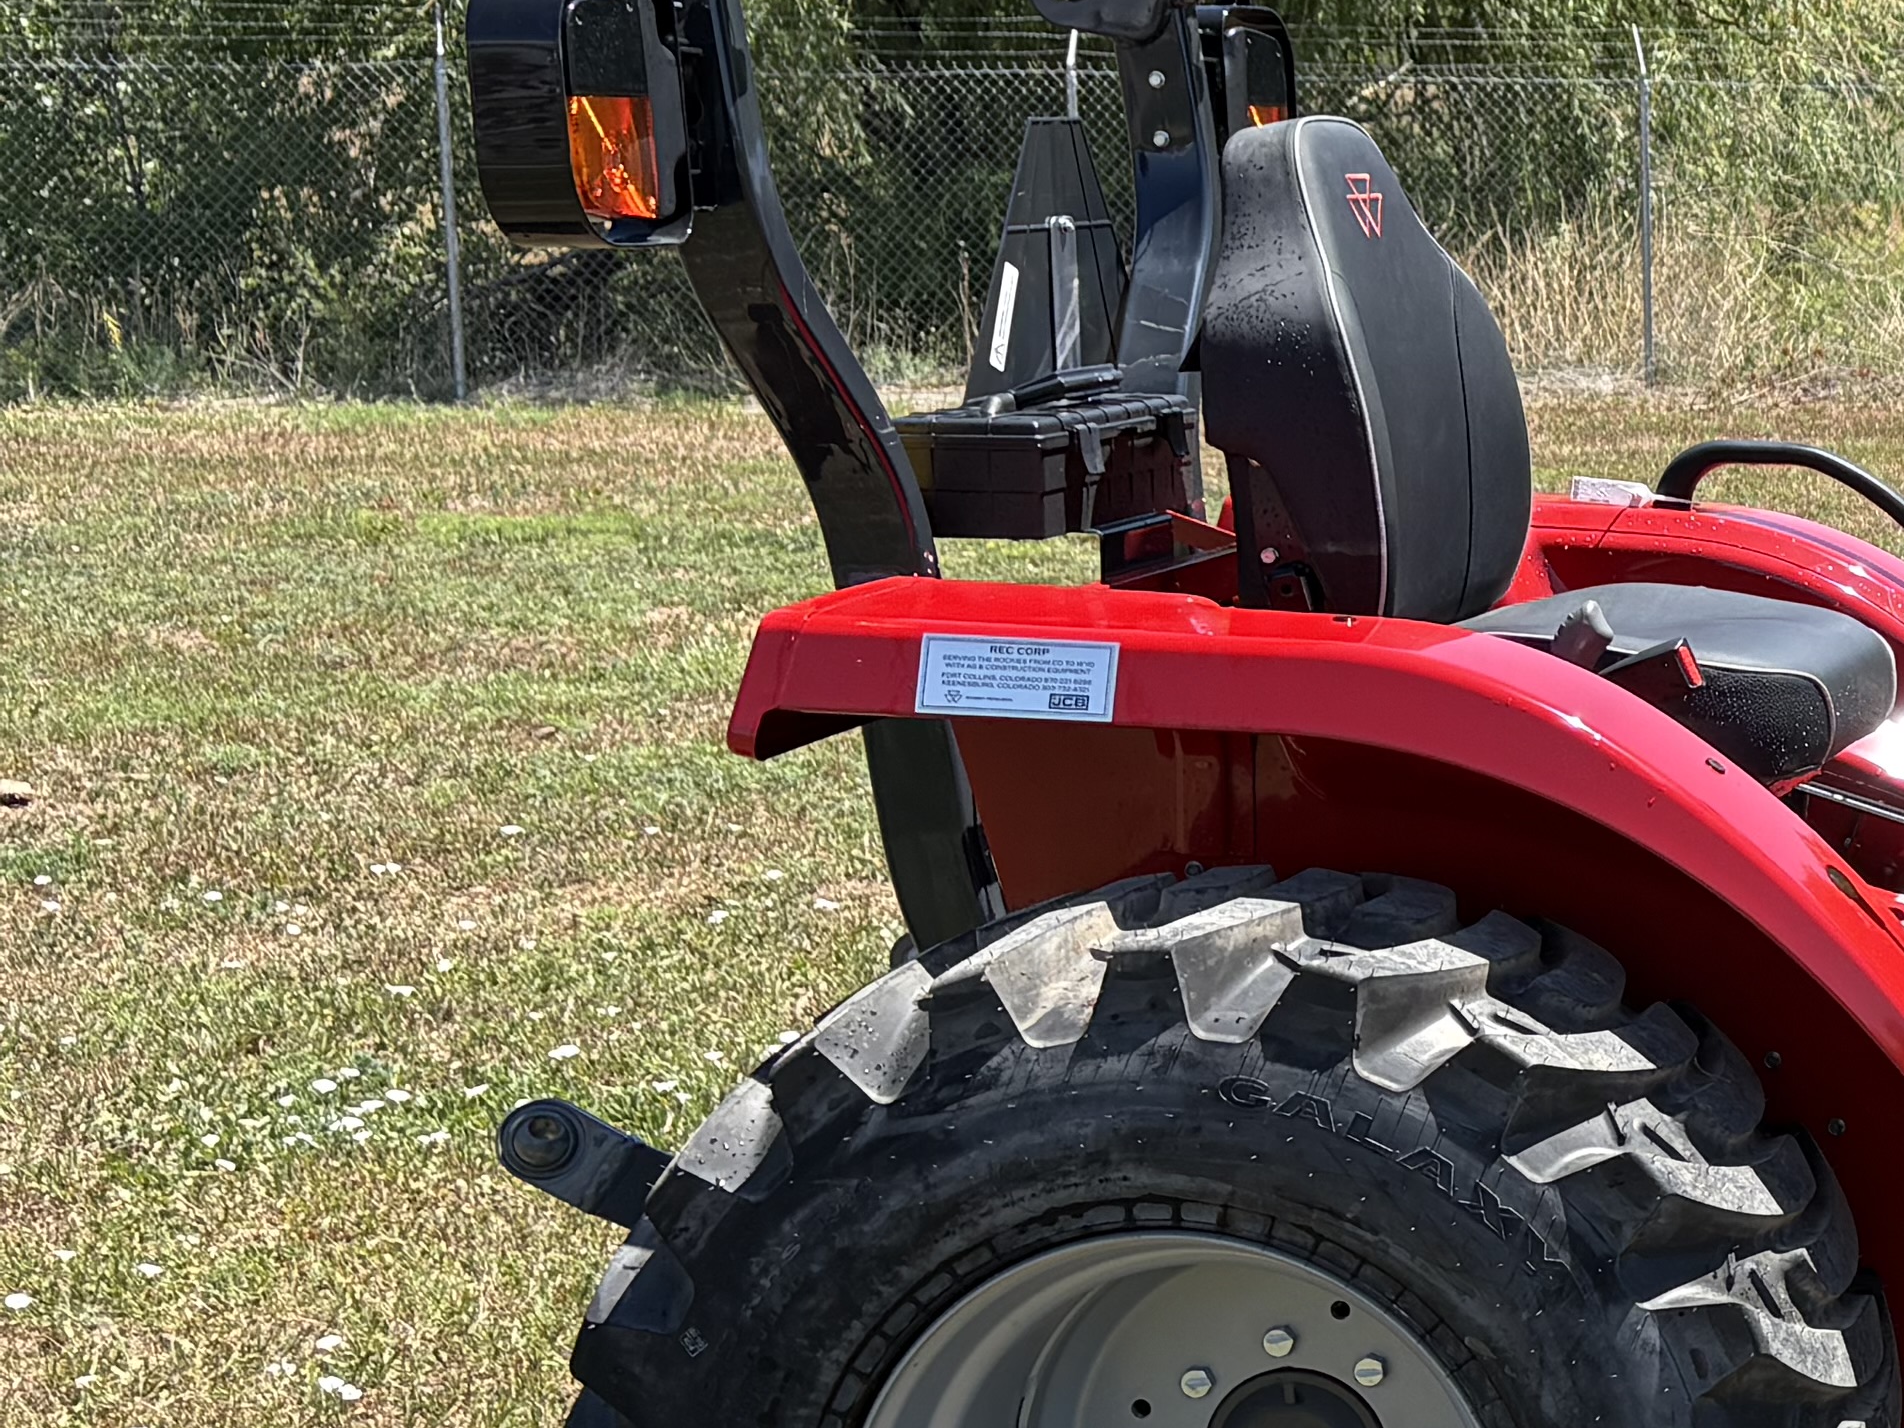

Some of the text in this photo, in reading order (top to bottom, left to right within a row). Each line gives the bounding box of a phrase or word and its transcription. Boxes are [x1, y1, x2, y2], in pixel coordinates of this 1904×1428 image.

[990, 645, 1051, 657] REC CORP
[985, 663, 1045, 673] CONSTRUCTION
[1047, 667, 1091, 676] EQUIPMENT
[941, 671, 962, 679] FORT
[999, 675, 1043, 684] COLORADO
[996, 683, 1041, 691] COLORADO
[1051, 696, 1087, 708] JCB
[1217, 1074, 1570, 1276] GALAXY
